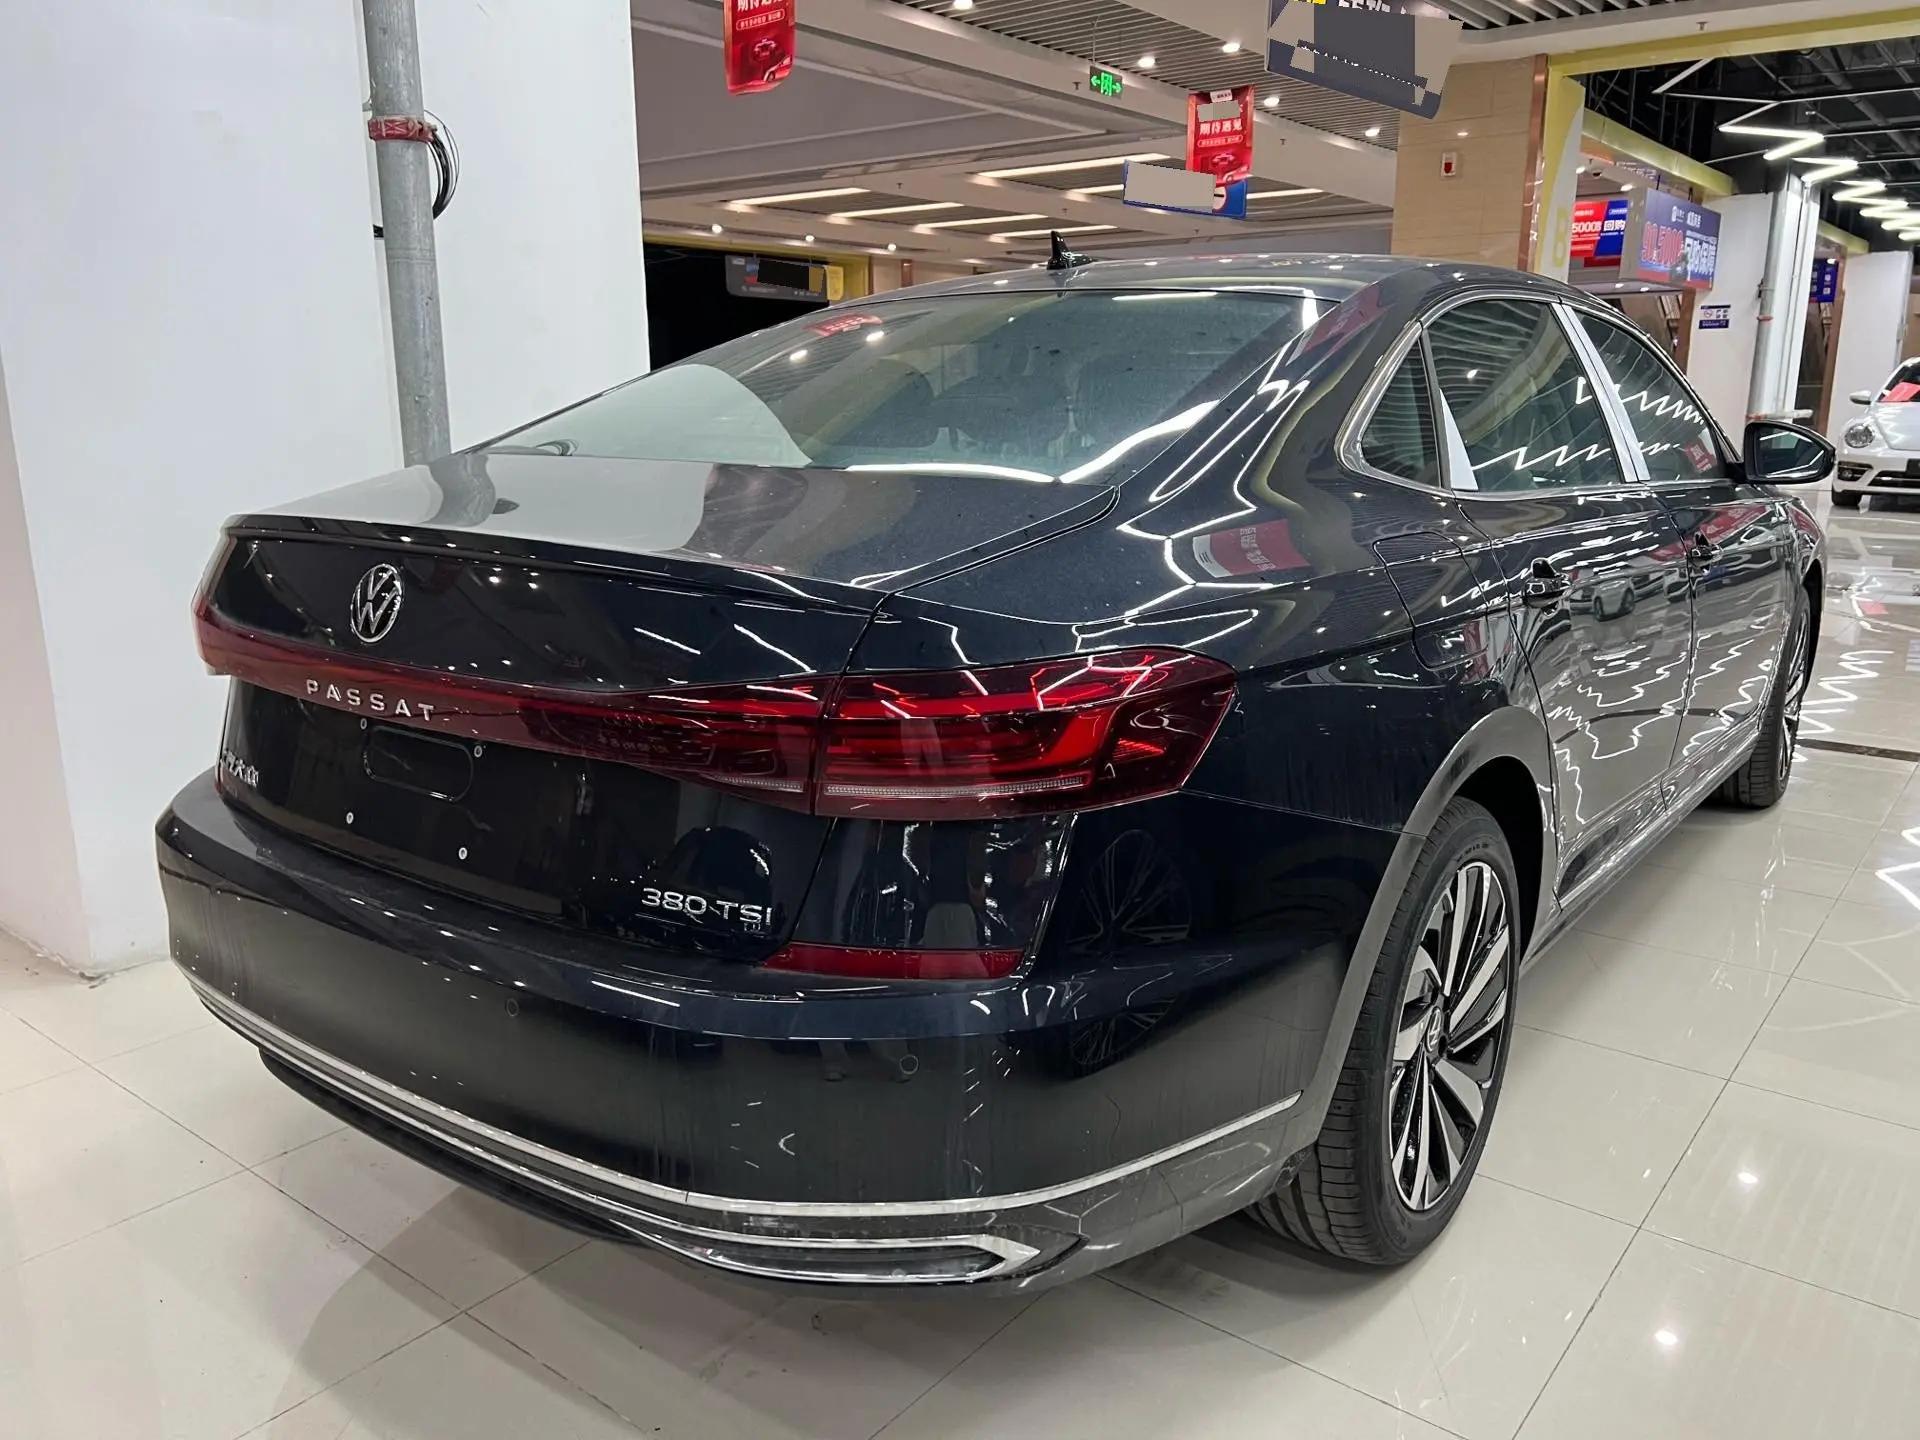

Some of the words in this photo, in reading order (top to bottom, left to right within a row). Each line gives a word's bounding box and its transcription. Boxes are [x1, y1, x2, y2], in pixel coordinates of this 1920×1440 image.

[305, 678, 435, 722] PASSAT
[641, 887, 707, 915] 380
[715, 899, 773, 926] TSI
